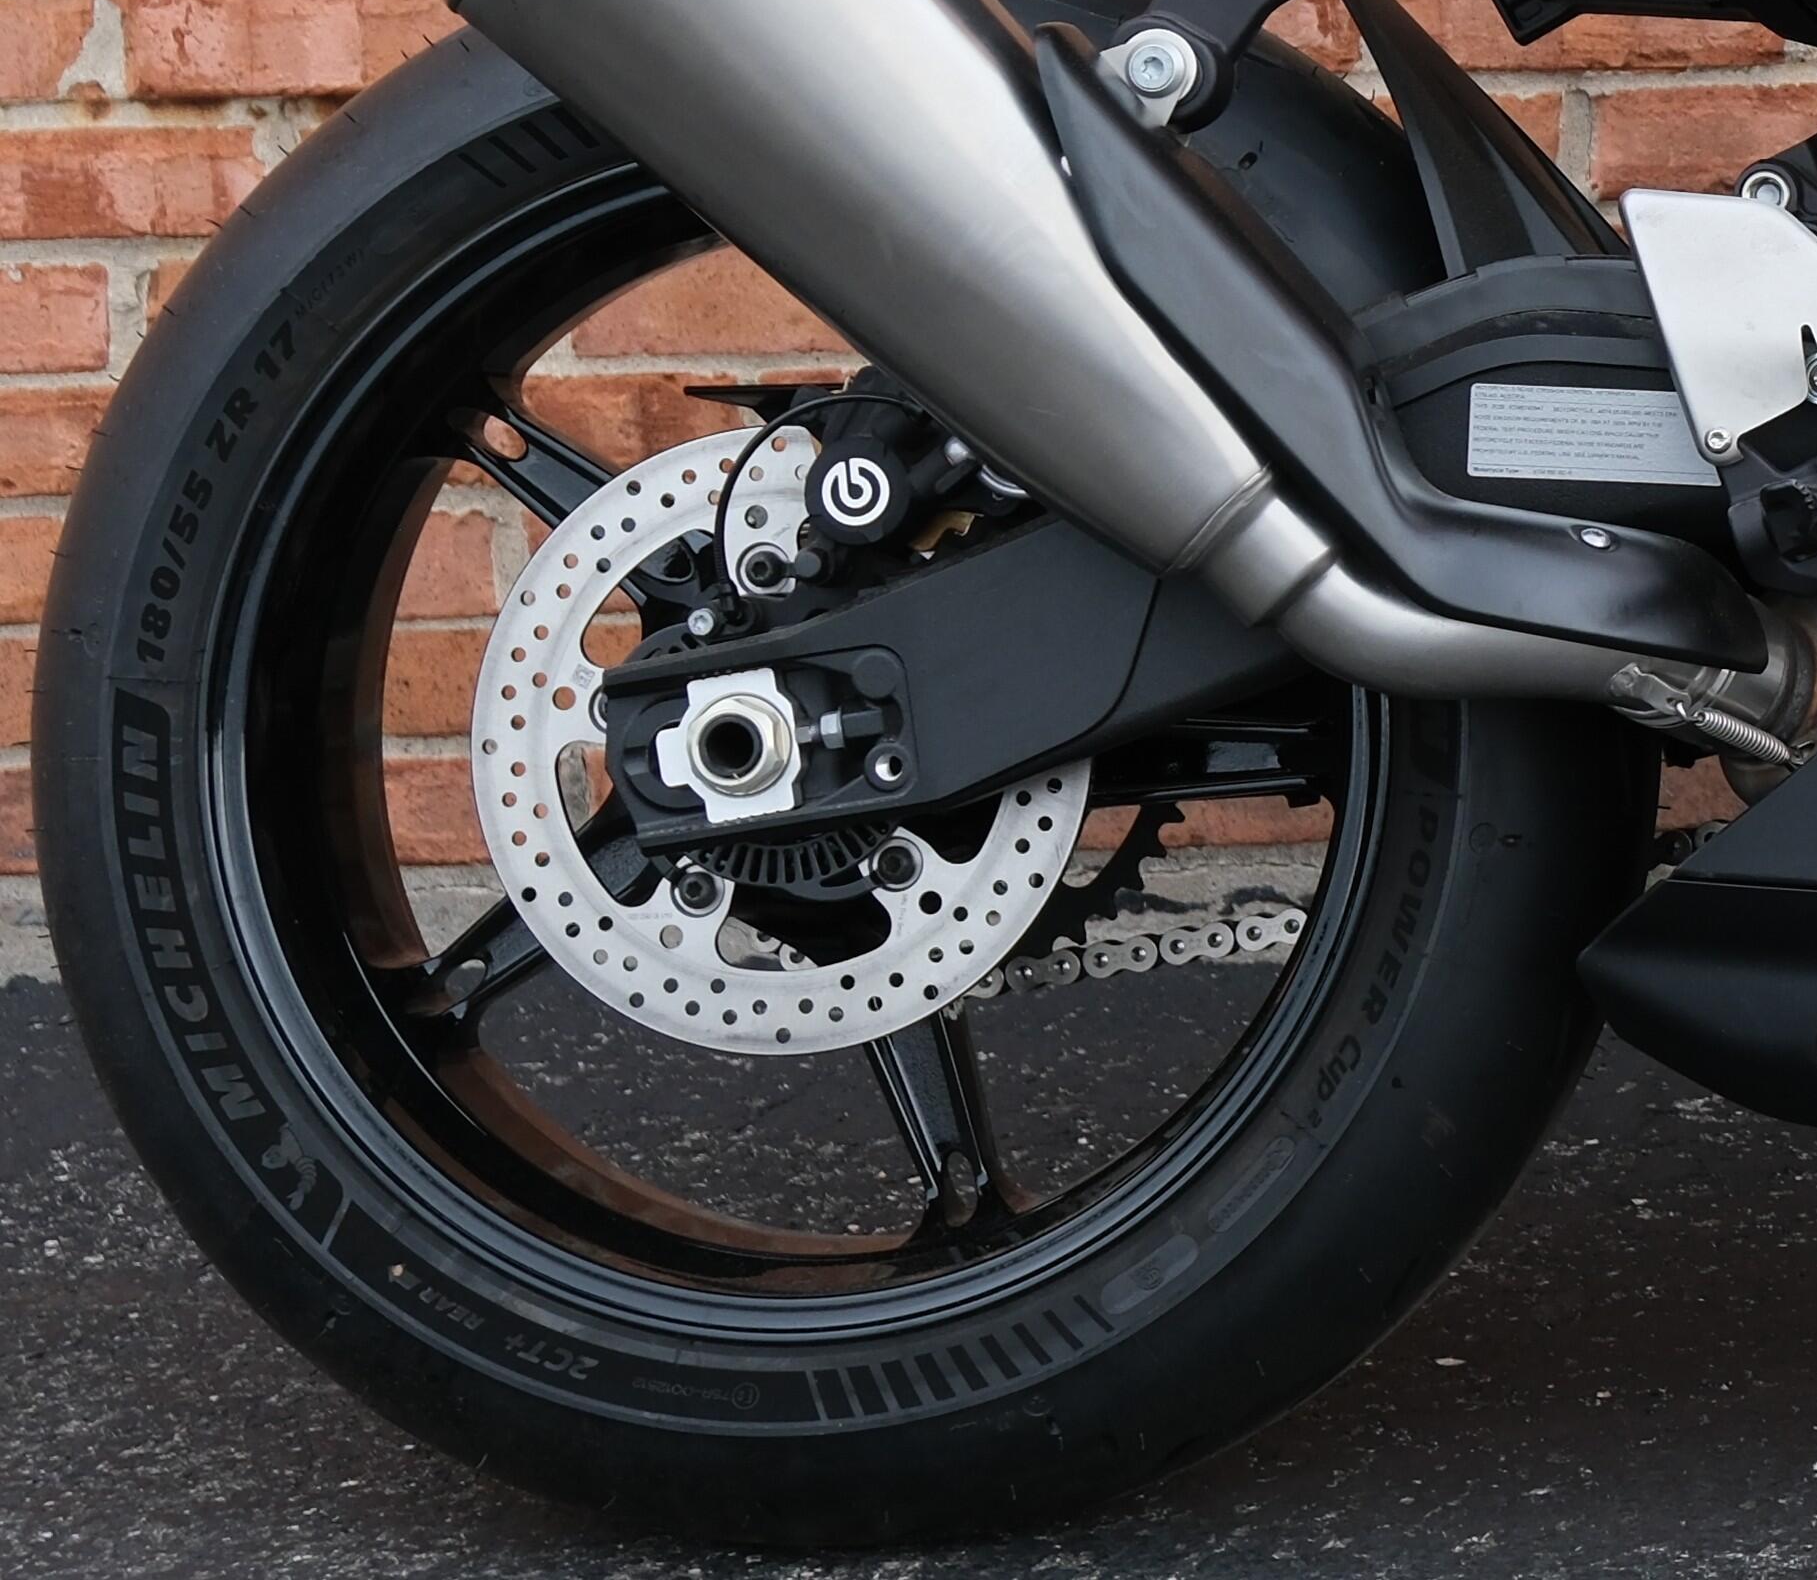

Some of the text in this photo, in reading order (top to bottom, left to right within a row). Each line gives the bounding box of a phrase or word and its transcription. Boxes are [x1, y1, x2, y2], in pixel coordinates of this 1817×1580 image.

[136, 468, 214, 663] 180/55
[204, 386, 259, 463] ZR
[253, 320, 297, 381] 17
[122, 725, 267, 1120] MICHELIN
[1360, 802, 1440, 1026] POWER
[1318, 1034, 1362, 1103] Cup
[419, 1285, 600, 1381] 2CT+ REAR
